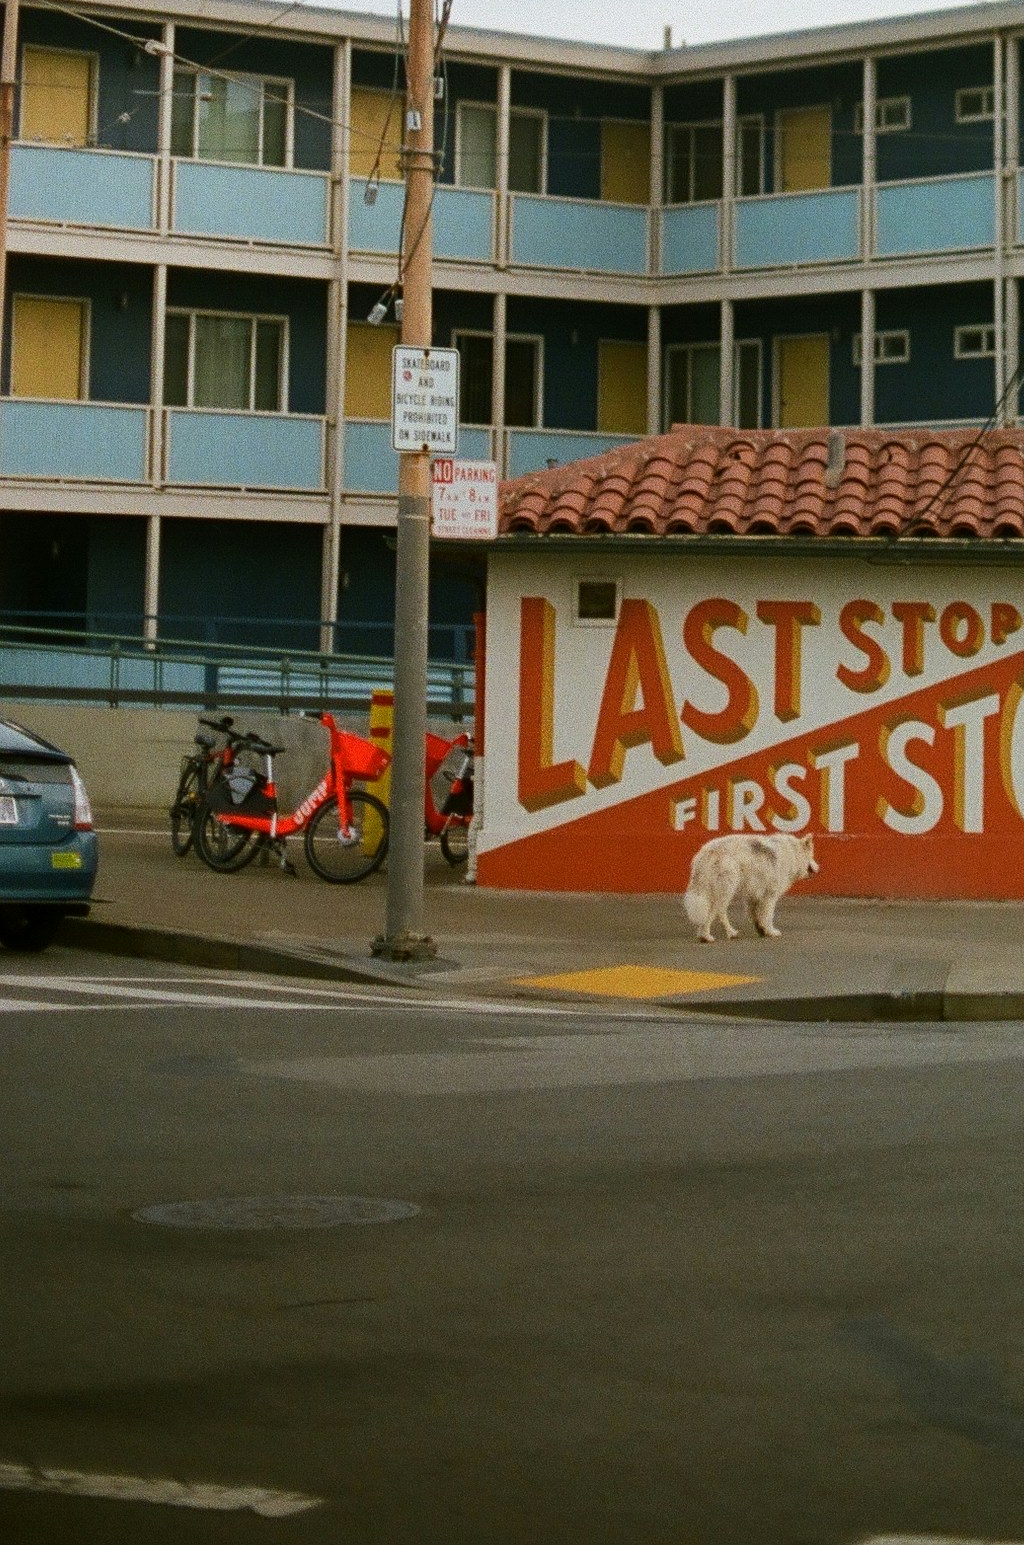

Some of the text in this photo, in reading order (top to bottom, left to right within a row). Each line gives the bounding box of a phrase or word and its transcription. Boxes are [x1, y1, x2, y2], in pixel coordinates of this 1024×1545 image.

[402, 357, 450, 372] SKATEBOARD
[418, 376, 434, 388] AND
[396, 393, 455, 407] BICYCLE RIDING
[403, 411, 448, 425] PROHIBITED
[399, 429, 451, 443] ON SIDEWALK
[433, 461, 495, 483] NO PARKING
[439, 508, 457, 521] TUE
[474, 509, 490, 522] FRI
[517, 596, 1023, 814] LAST STOP
[670, 735, 859, 833] FIRST
